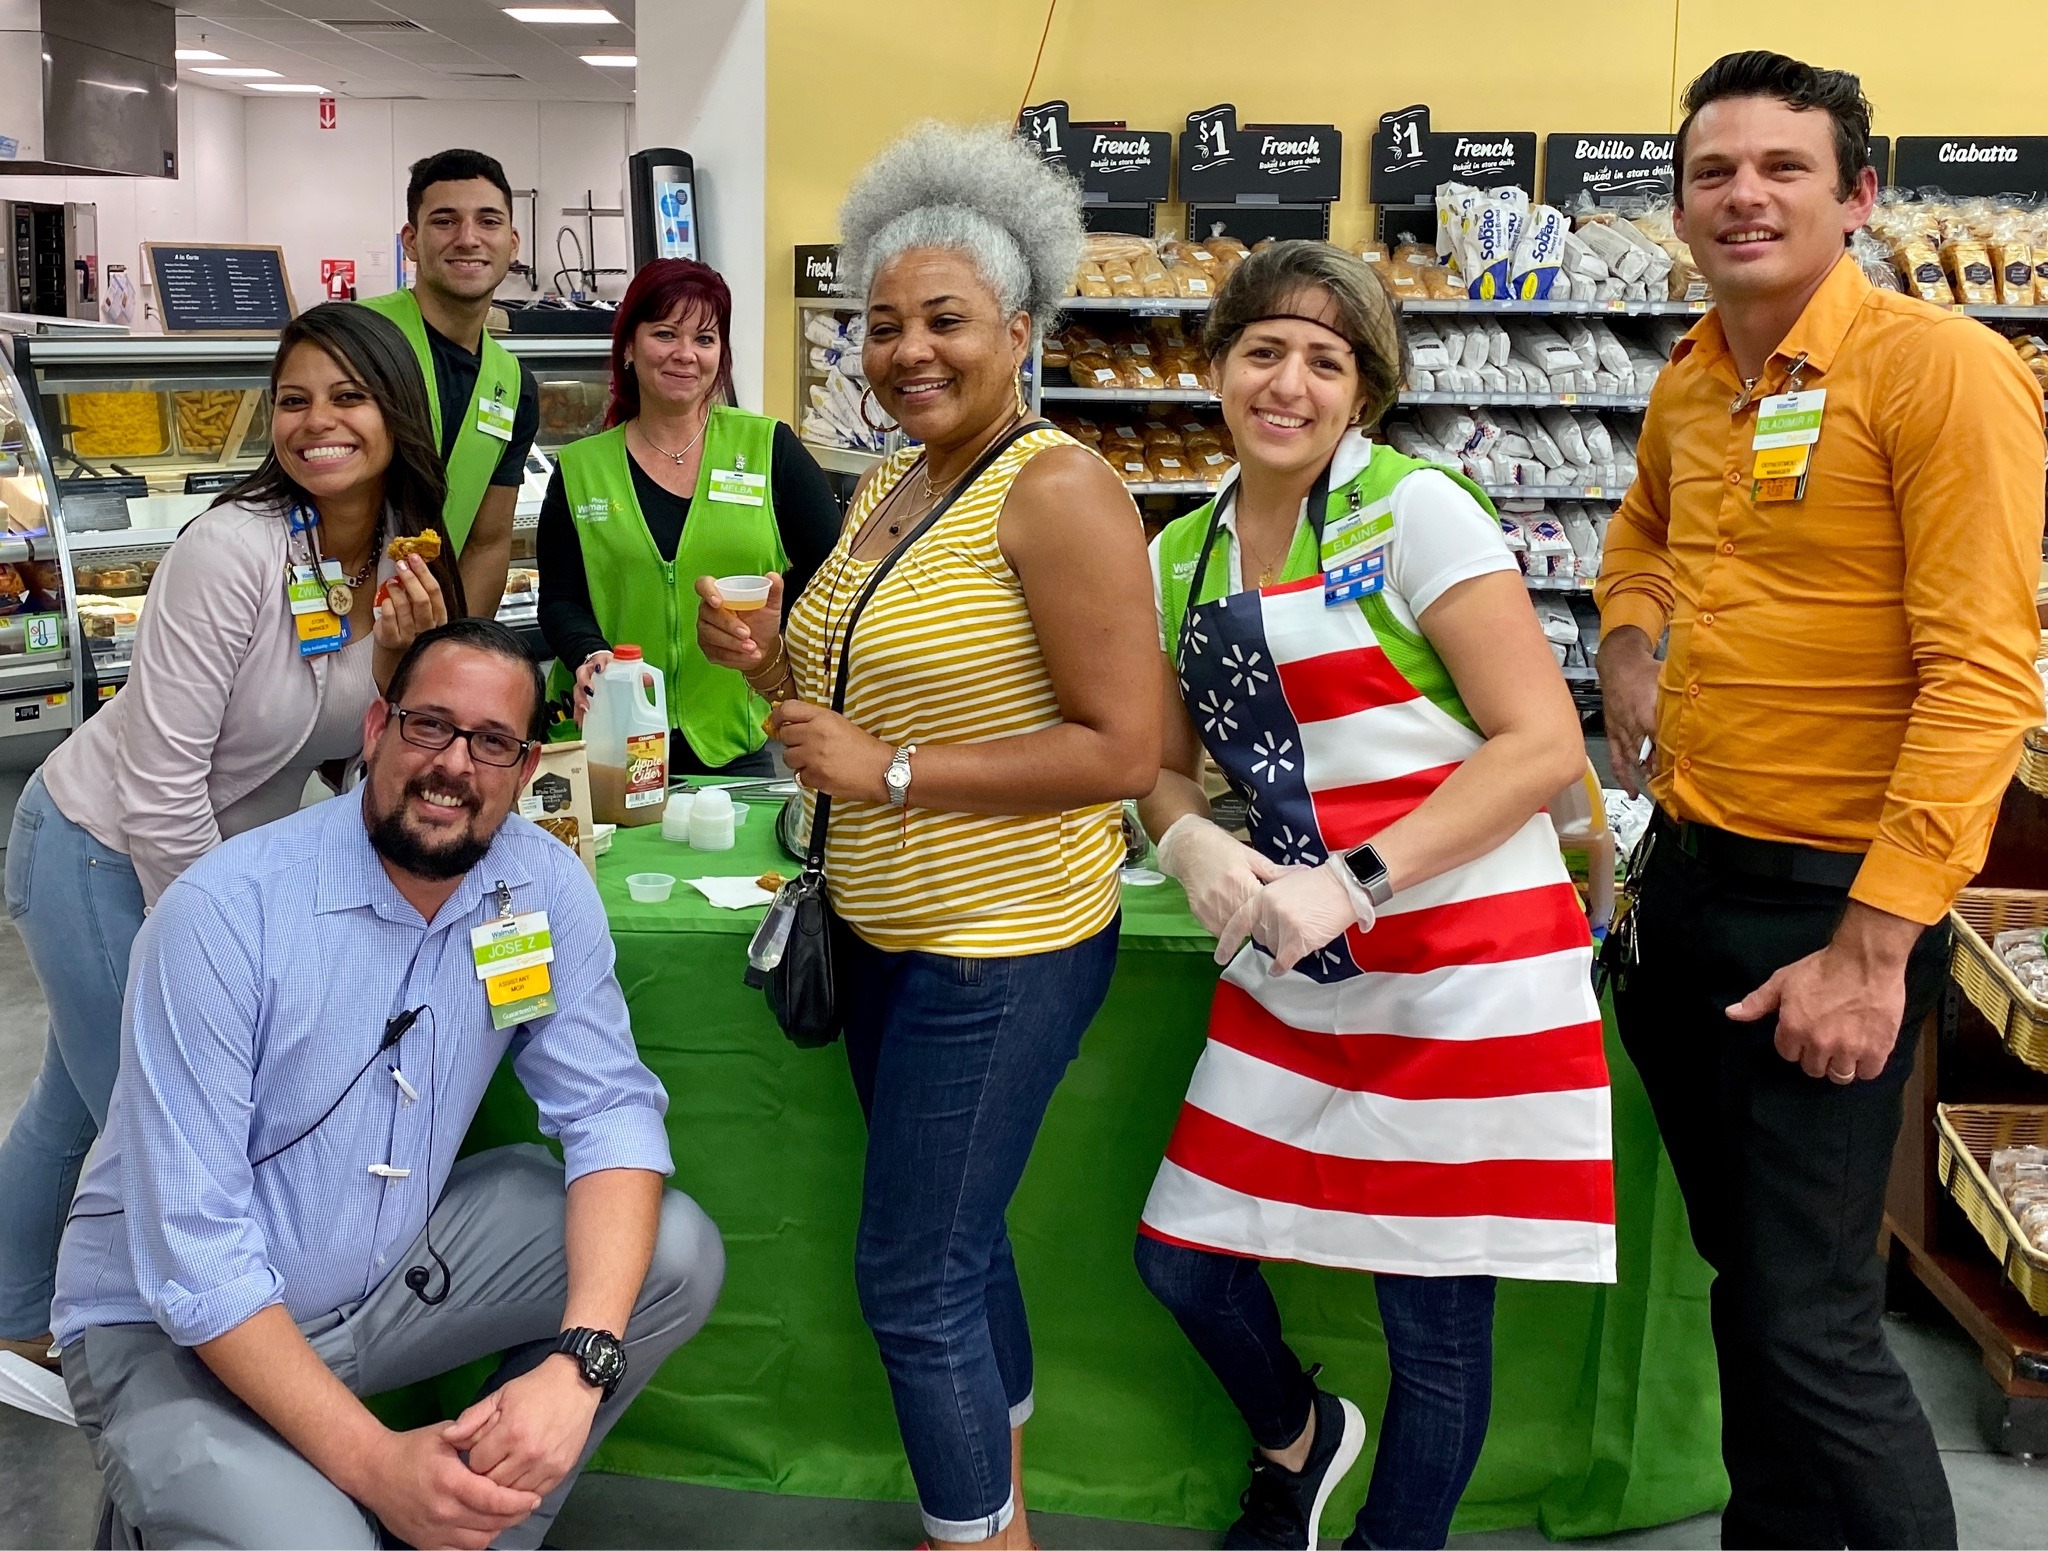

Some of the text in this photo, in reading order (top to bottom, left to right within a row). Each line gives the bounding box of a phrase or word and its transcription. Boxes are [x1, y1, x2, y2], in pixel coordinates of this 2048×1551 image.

[1033, 116, 1062, 152] $1
[1200, 120, 1230, 156] $1
[1393, 122, 1423, 158] $1
[1093, 135, 1150, 155] French
[1261, 135, 1320, 155] French
[1455, 137, 1514, 157] French
[1575, 140, 1635, 160] Bolillo
[1938, 142, 2018, 162] Ciabatta
[1090, 160, 1108, 168] Baked
[1259, 161, 1278, 169] Baked
[1452, 162, 1471, 171] Baked
[1473, 161, 1479, 169] in
[1583, 171, 1611, 182] Baked
[1614, 170, 1623, 179] in
[1627, 168, 1649, 178] store
[1479, 209, 1494, 260] Sobao
[1532, 214, 1555, 262] Sobao
[806, 255, 834, 280] Fresh,
[720, 484, 753, 495] MELBA
[1333, 521, 1379, 552] ELAINE
[629, 755, 664, 772] Apple
[632, 768, 662, 784] Cider
[491, 927, 518, 938] Walmart
[488, 936, 537, 959] JOSE Z
[502, 1006, 532, 1020] Guaranteed
